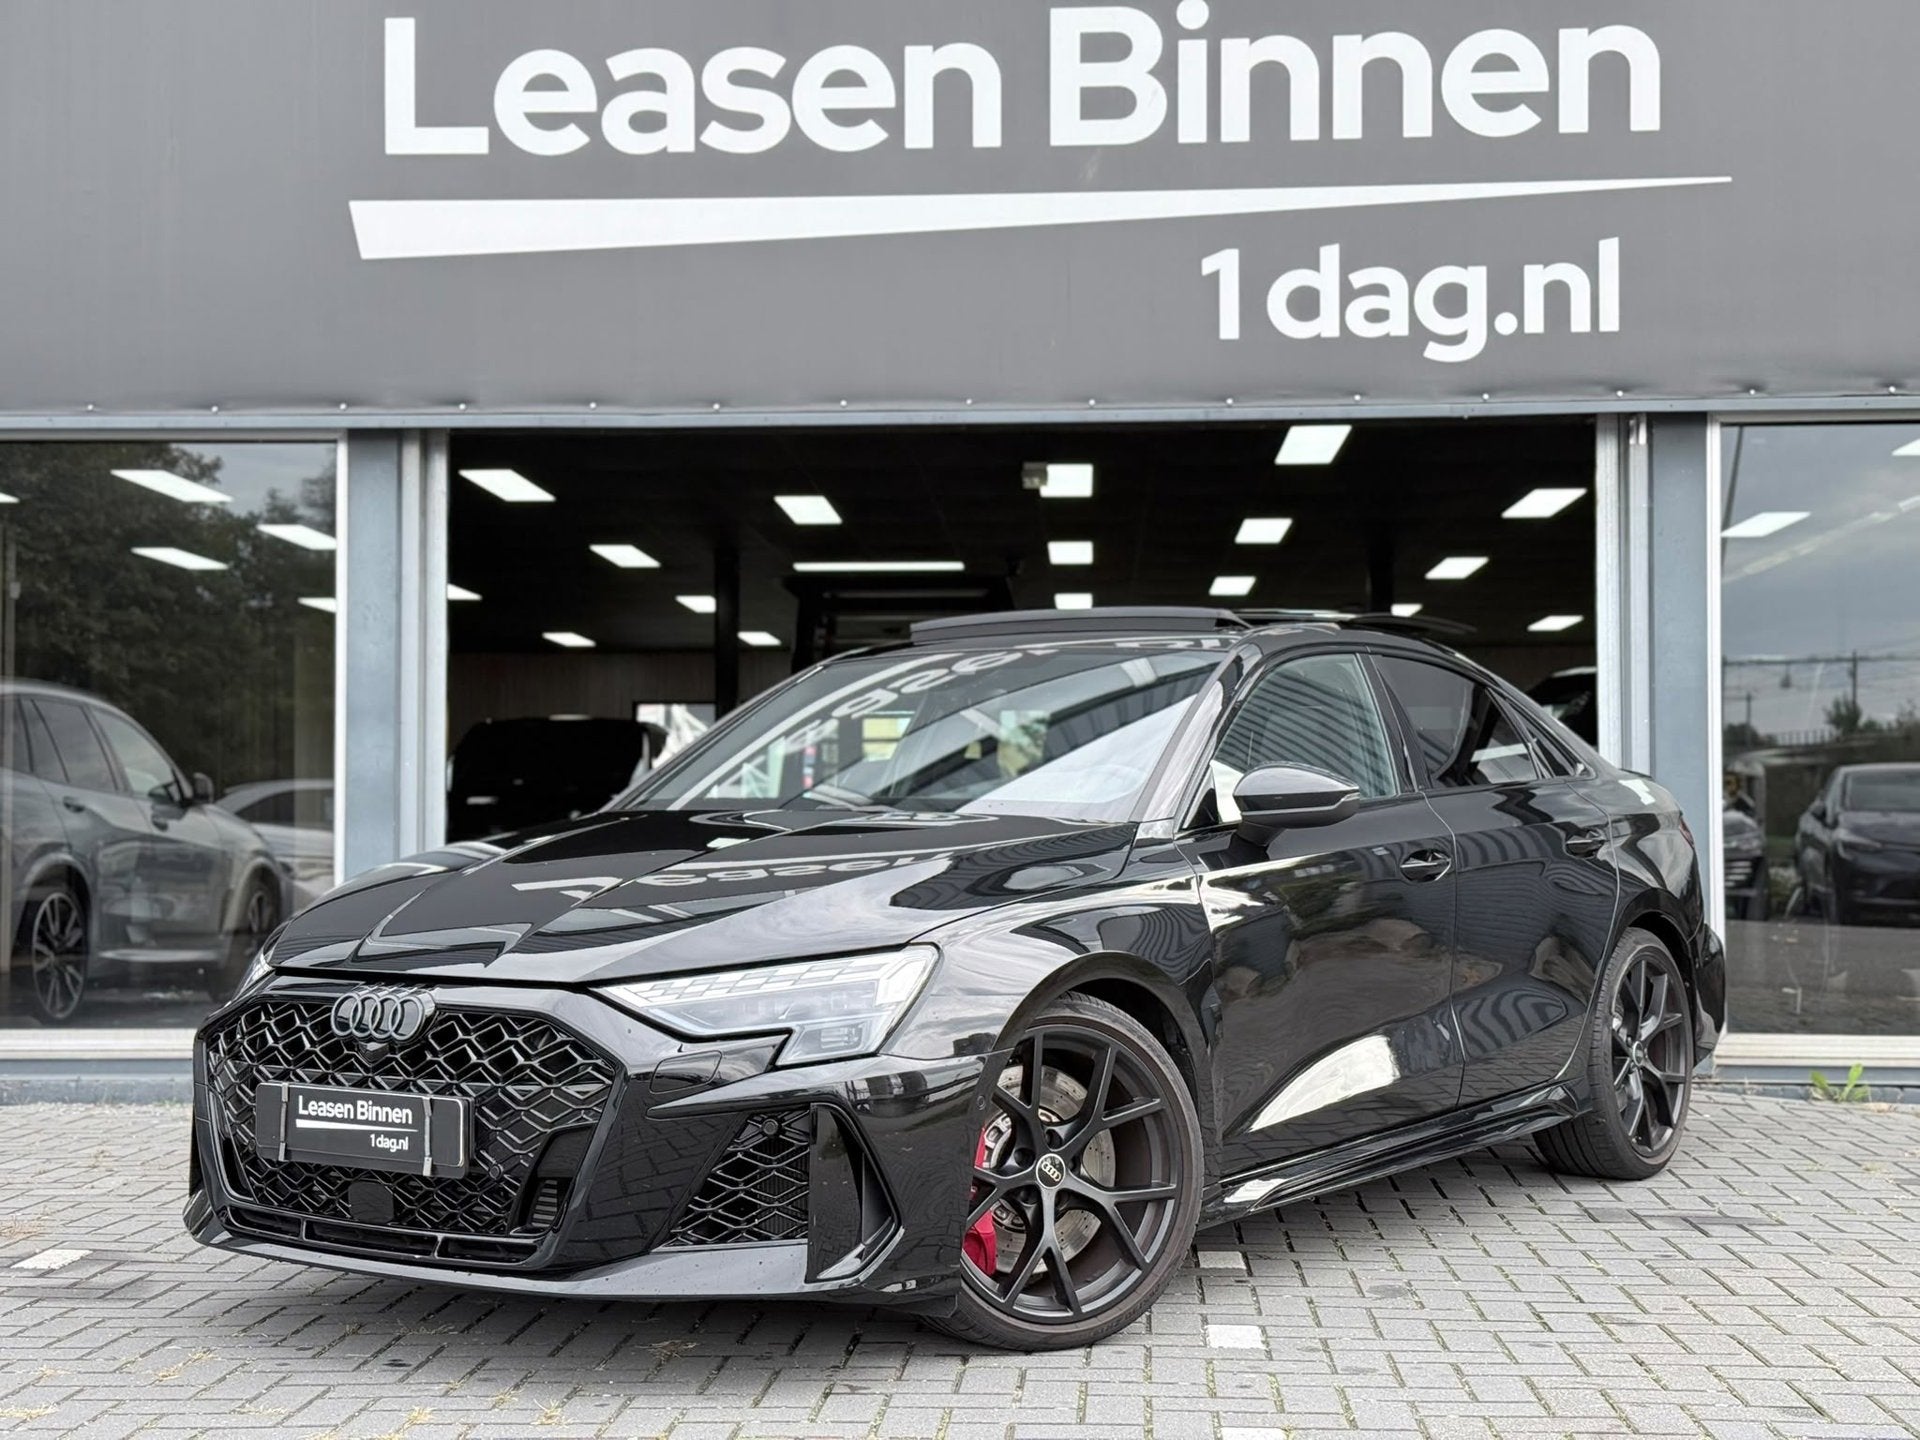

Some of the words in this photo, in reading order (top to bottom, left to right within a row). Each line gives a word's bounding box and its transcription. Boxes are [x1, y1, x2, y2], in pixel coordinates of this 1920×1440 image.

[383, 16, 1002, 157] Leasen
[1049, 0, 1661, 147] Binnen
[298, 1094, 355, 1120] Leasen
[356, 1100, 413, 1125] Binnen
